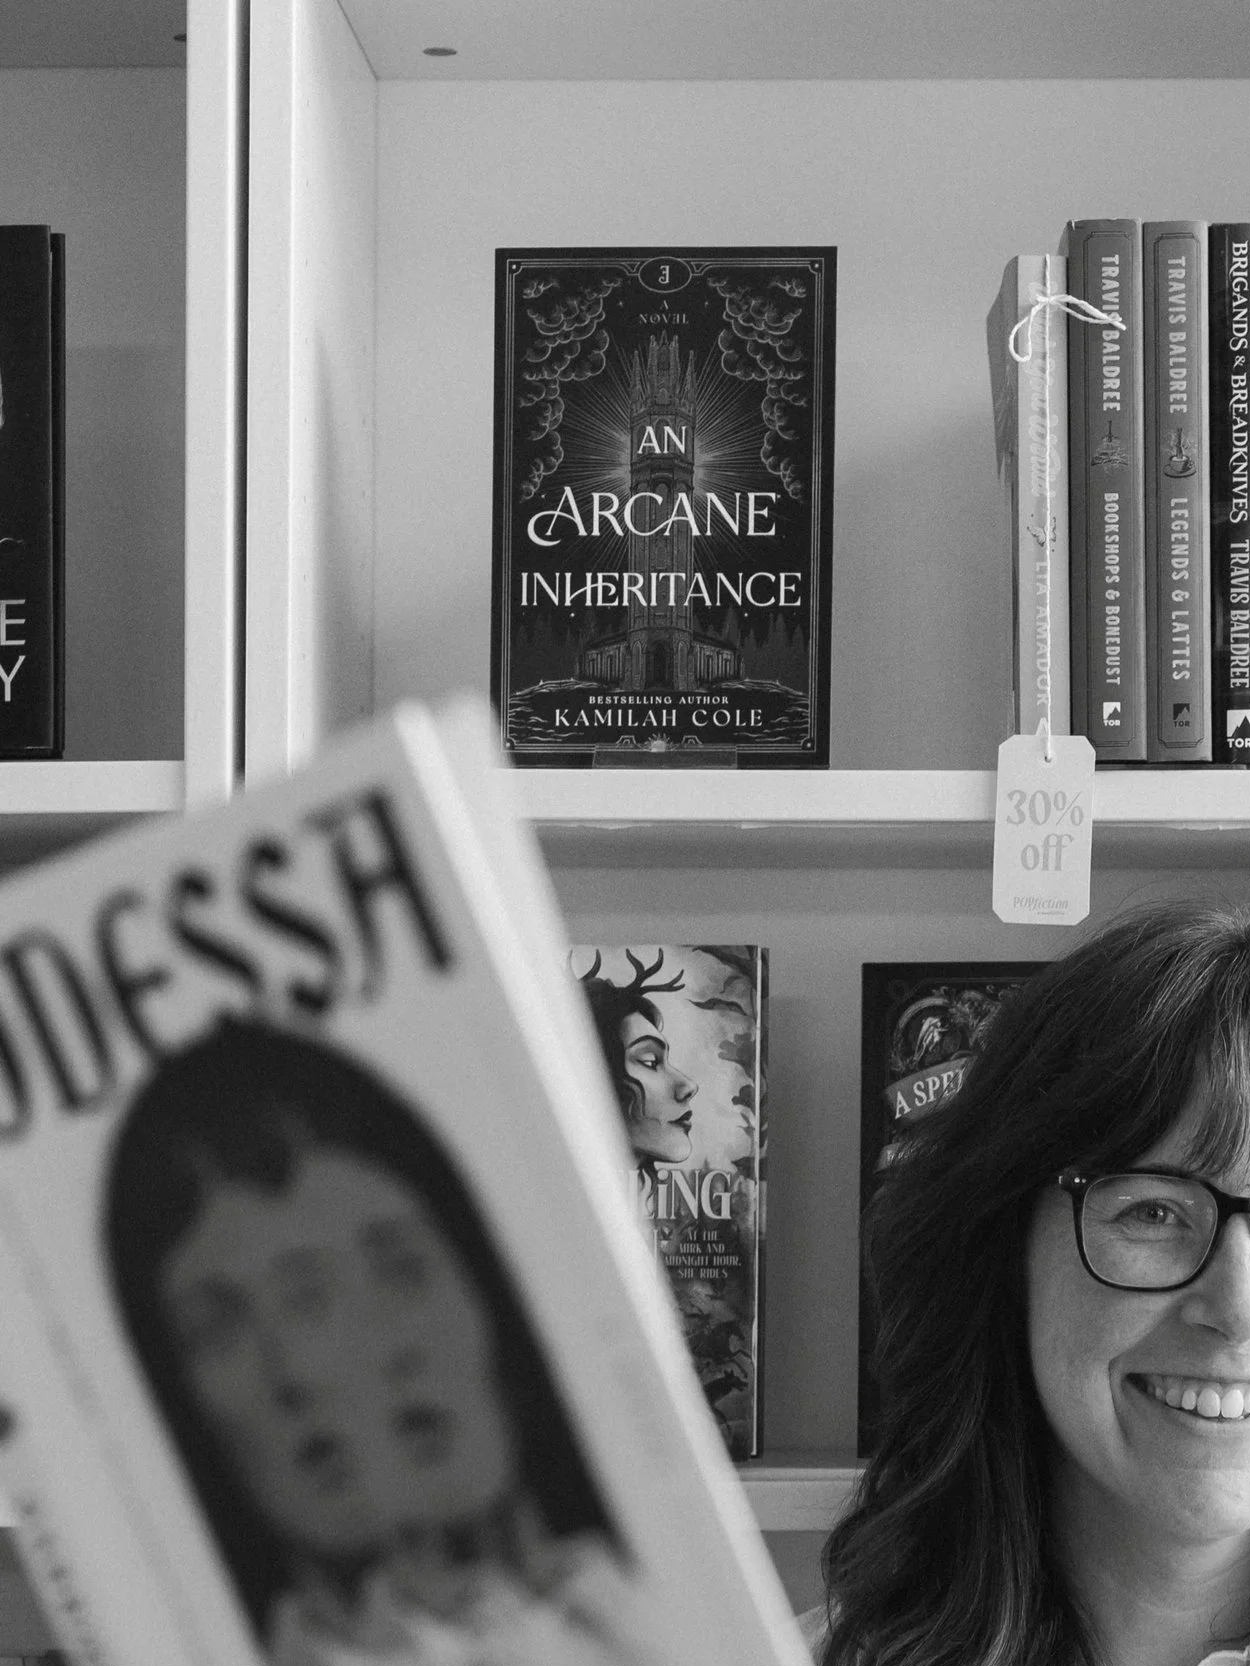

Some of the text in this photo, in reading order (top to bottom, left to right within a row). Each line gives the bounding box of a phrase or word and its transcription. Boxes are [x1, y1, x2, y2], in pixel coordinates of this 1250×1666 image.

[1101, 254, 1121, 411] TRAVIS BALDREE
[1168, 256, 1187, 413] TRAVIS BALDREE
[1230, 241, 1248, 523] BRIGANDS & BREADKNIVES
[637, 425, 687, 454] AN
[527, 486, 777, 547] ARCANE
[521, 571, 802, 607] INHERITANCE
[1035, 561, 1049, 597] LIA
[1104, 493, 1120, 685] BOOKSHOPS & BONEDUST
[1170, 498, 1190, 680] LEGENDS & LATTES
[1230, 539, 1250, 688] TRAVIS BALDREE
[555, 709, 763, 727] KAMILAH COLE
[589, 696, 729, 704] BESTSELLING AUTHOR
[1006, 789, 1084, 826] 30%
[1021, 833, 1074, 872] off
[0, 786, 455, 1142] DESSA
[894, 1091, 911, 1120] A
[707, 1243, 725, 1253] AND
